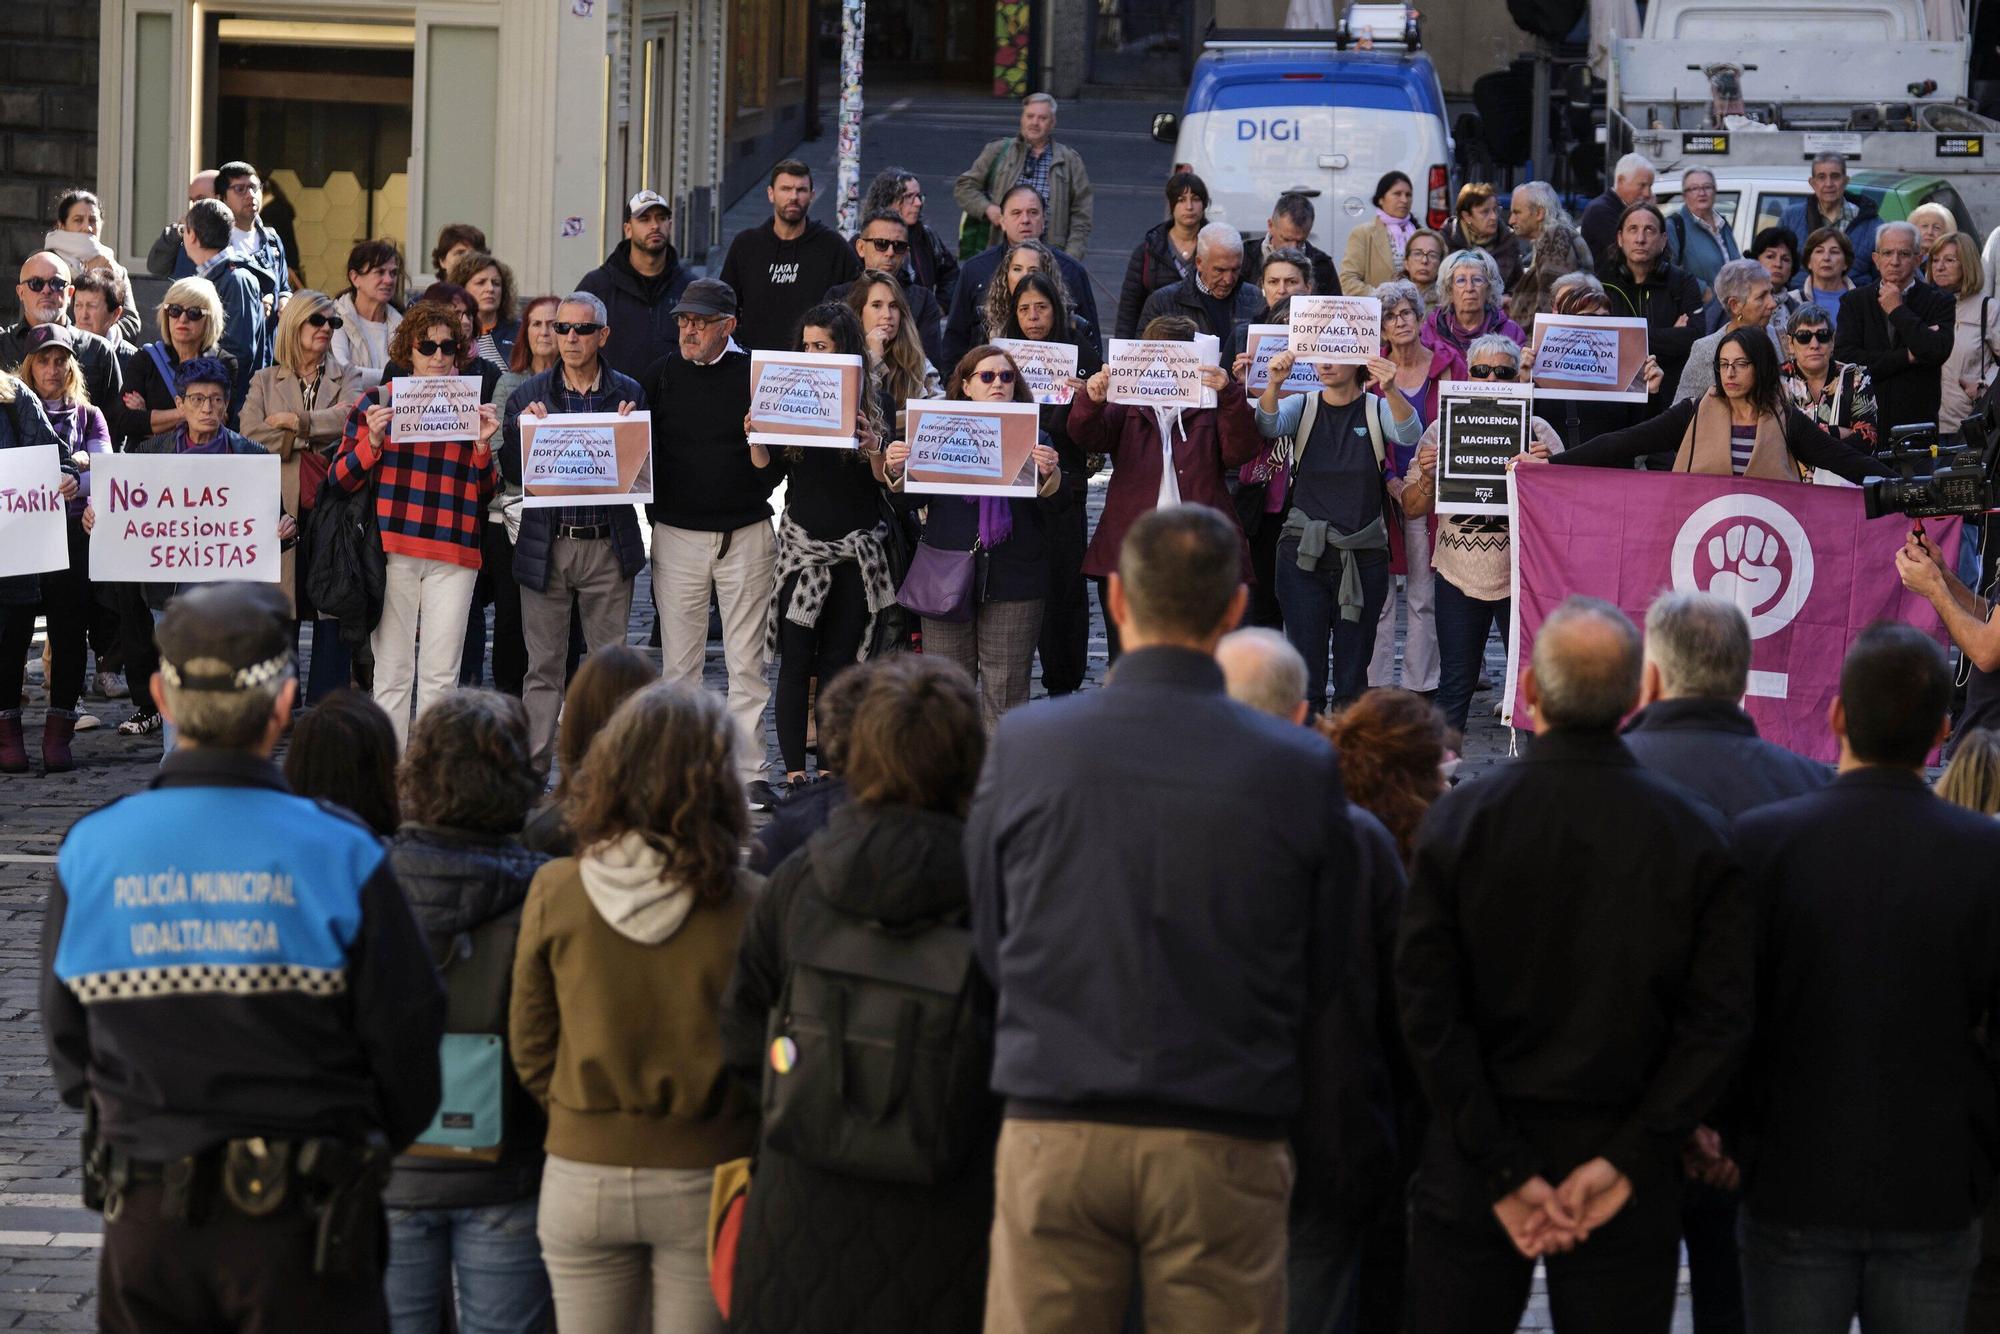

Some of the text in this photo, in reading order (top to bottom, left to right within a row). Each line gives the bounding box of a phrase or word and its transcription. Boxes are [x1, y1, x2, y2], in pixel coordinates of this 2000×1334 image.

[771, 273, 797, 284] PLOMO
[1294, 312, 1334, 320] Eufemismos
[1292, 325, 1378, 336] BORTXAKETA DA.
[1297, 343, 1308, 352] ES
[1311, 342, 1369, 354] VIOLACIÓN!
[1542, 346, 1616, 359] BORTXAKETA DA.
[1112, 354, 1155, 362] Eufemismos
[1020, 366, 1054, 376] XAKETA
[1542, 360, 1552, 368] ES
[1554, 361, 1607, 373] VIOLACIÓN!
[1112, 368, 1199, 379] BORTXAKETA DA.
[1258, 370, 1268, 378] ES
[450, 391, 478, 399] gracias!!
[760, 386, 839, 400] BORTXAKETA DA.
[1130, 386, 1189, 396] VIOLACIÓN!
[396, 404, 478, 414] BORTXAKETA DA.
[760, 402, 770, 410] ES
[773, 403, 830, 416] VIOLACIÓN!
[401, 421, 469, 431] ES VIOLACIÓN!
[1455, 416, 1518, 425] LA VIOLENCIA
[917, 434, 998, 448] BORTXAKETA DA.
[1461, 435, 1511, 445] MACHISTA
[533, 449, 614, 458] BORTXAKETA DA.
[918, 451, 990, 464] ES VIOLACIÓN!
[1454, 456, 1511, 464] QUE NO CES
[535, 464, 606, 474] ES VIOLACIÓN!
[0, 484, 60, 513] TARIK
[157, 487, 174, 508] A
[183, 486, 230, 508] LAS
[124, 516, 255, 540] AGRESIONES
[150, 541, 258, 568] SEXISTAS
[114, 866, 297, 908] POLICÍA MUNICIPAL
[130, 918, 280, 956] UDALTZAINGOA
